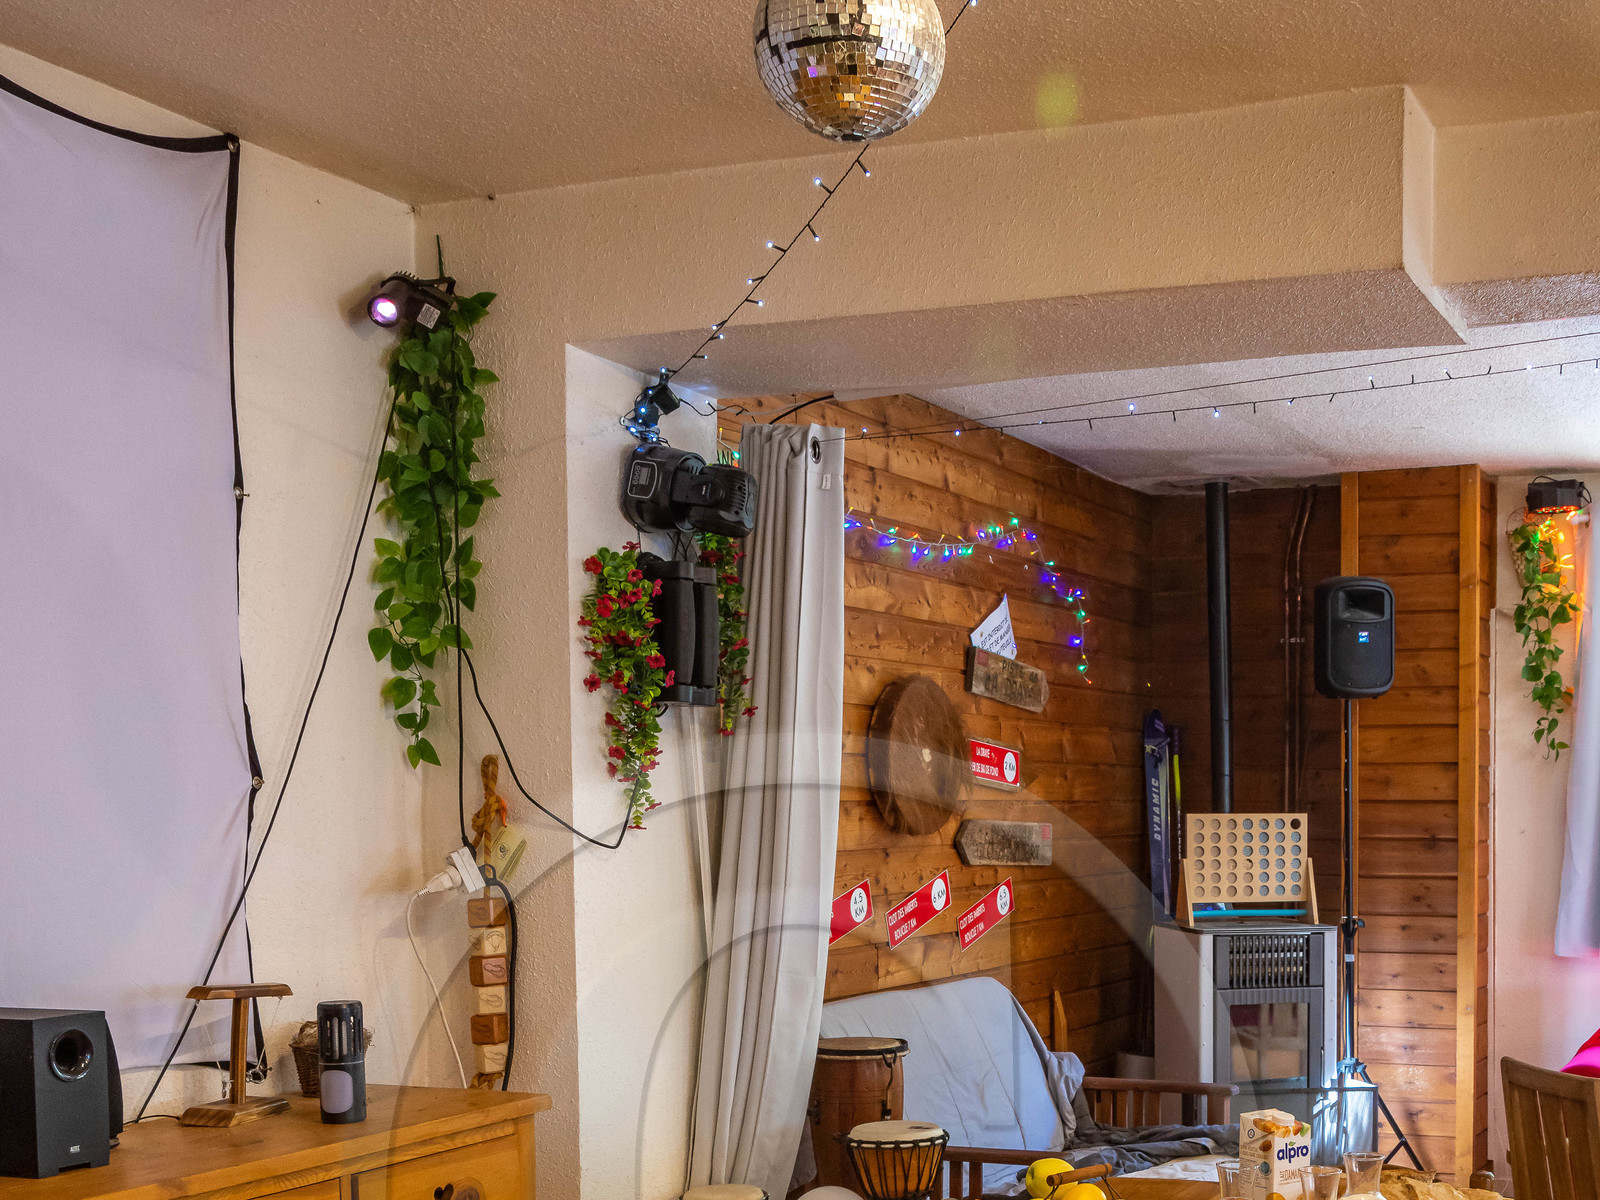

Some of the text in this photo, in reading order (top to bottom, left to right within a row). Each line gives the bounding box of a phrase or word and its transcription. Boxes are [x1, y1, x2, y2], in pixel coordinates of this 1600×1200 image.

[1008, 762, 1016, 772] KM
[1153, 777, 1162, 841] DYNAMIC
[853, 892, 864, 905] 4.5
[937, 887, 946, 900] KM
[854, 904, 865, 918] KM
[1000, 900, 1009, 911] KM
[1276, 1142, 1309, 1164] alpro
